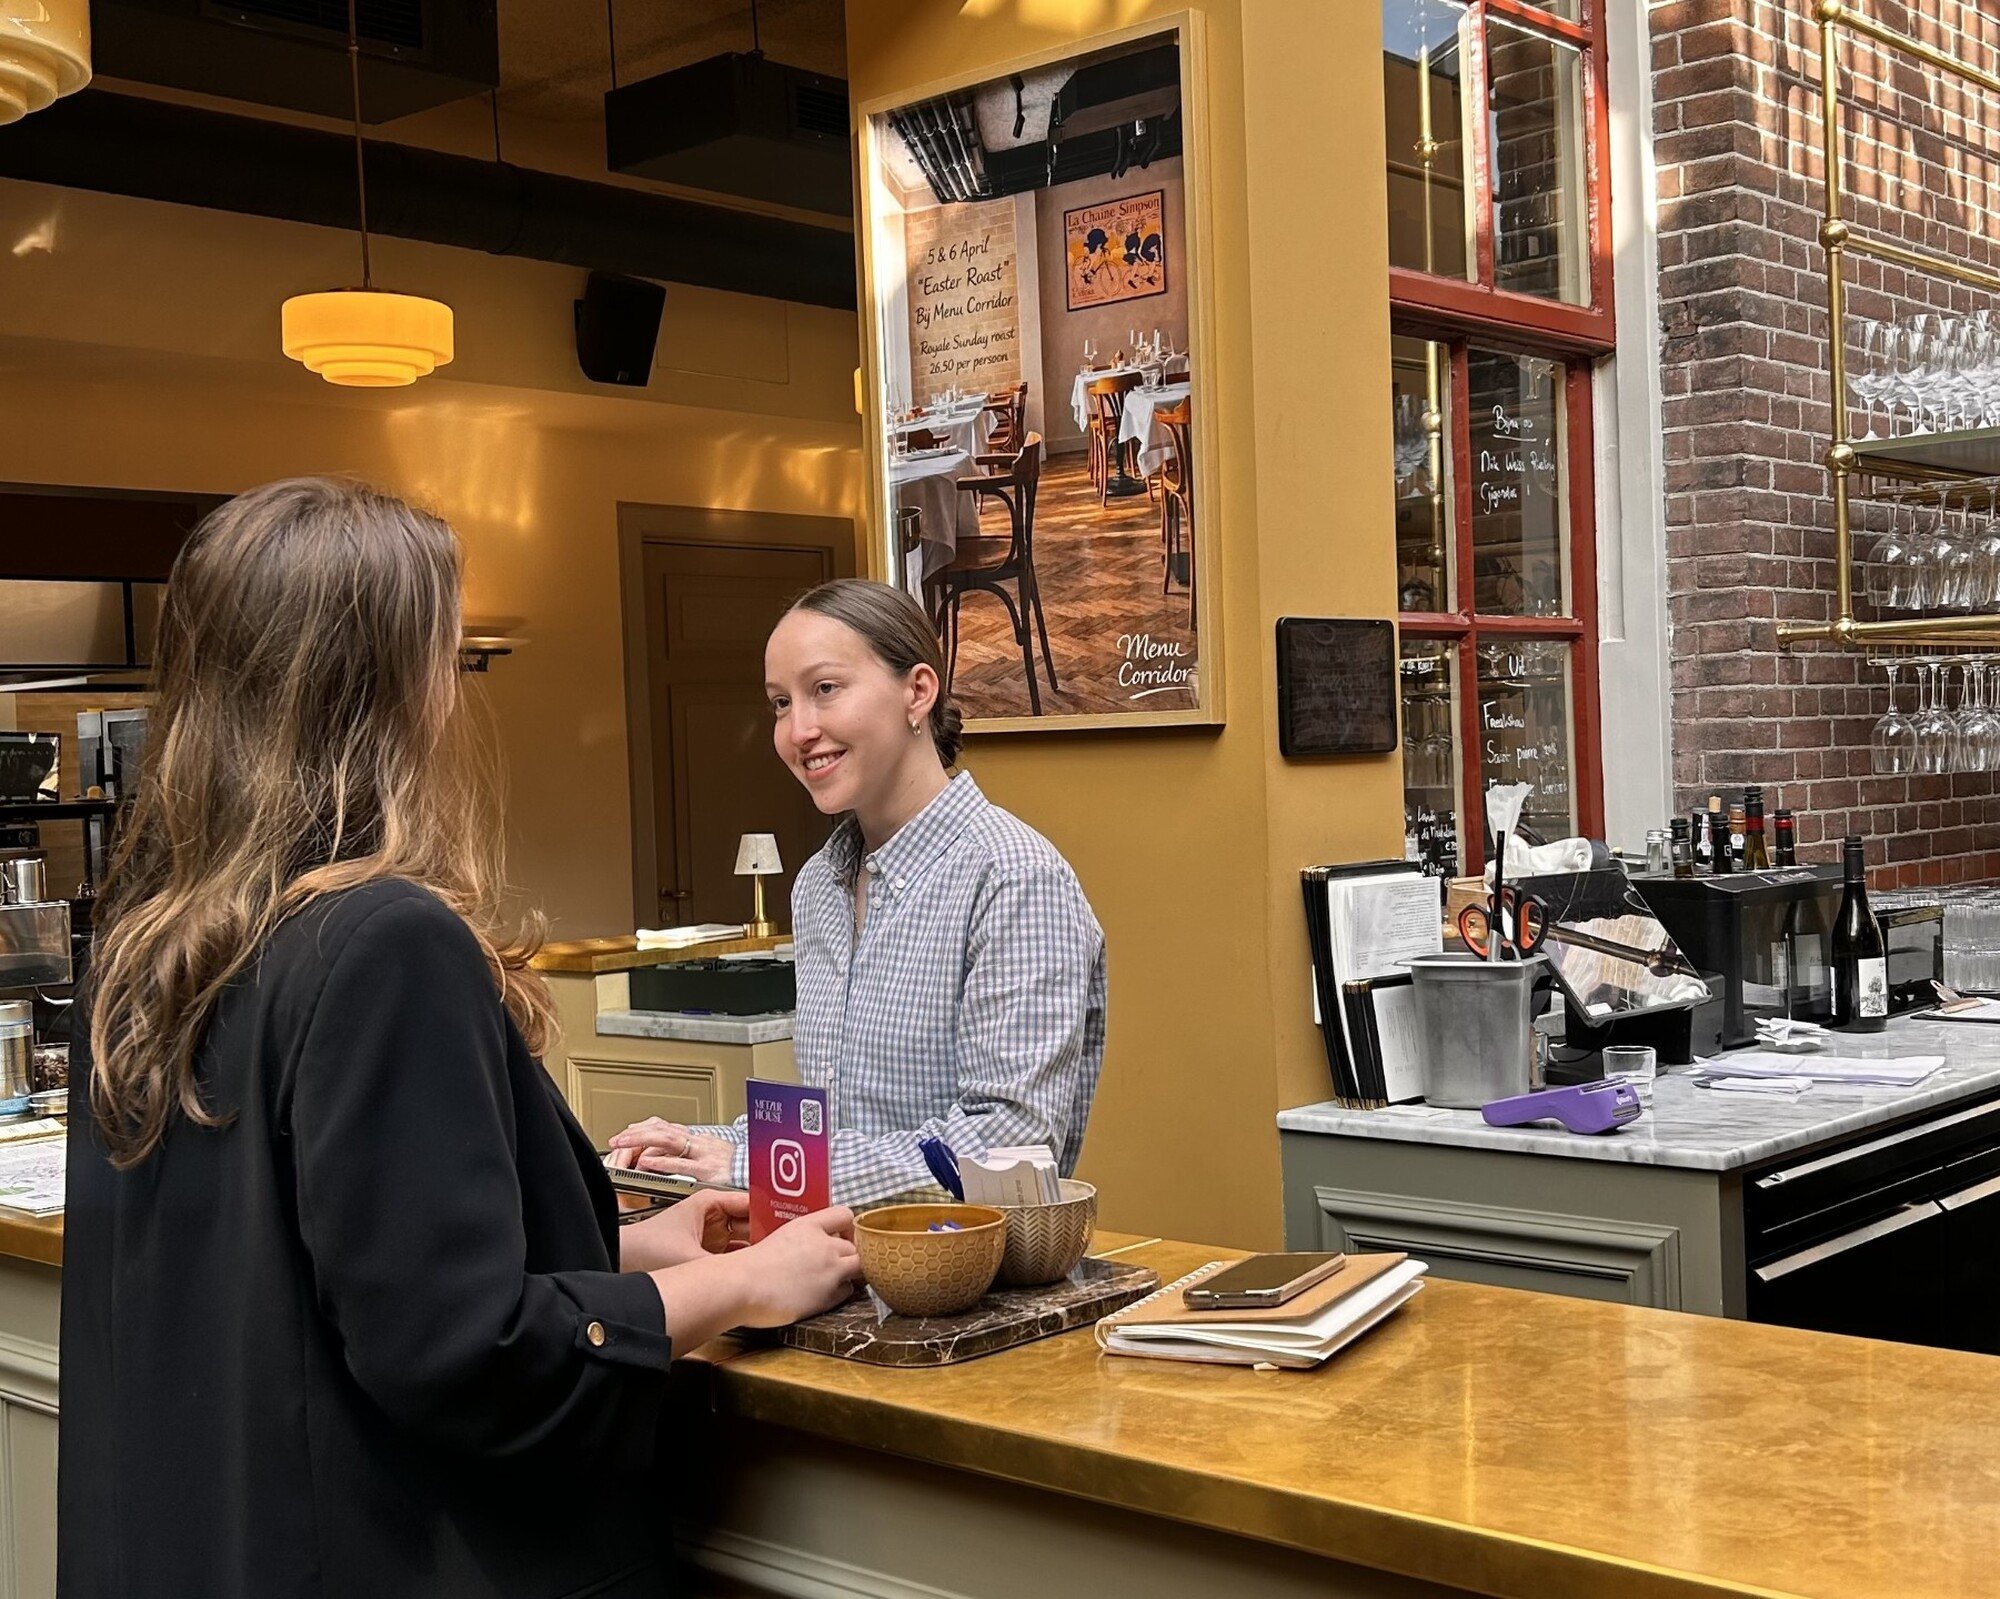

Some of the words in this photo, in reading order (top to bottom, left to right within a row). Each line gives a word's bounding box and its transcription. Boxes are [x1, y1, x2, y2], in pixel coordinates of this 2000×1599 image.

[1067, 214, 1080, 227] La
[1119, 198, 1160, 216] Simpson
[926, 248, 935, 265] 5
[937, 246, 946, 263] &
[949, 243, 957, 261] 6
[960, 234, 990, 263] April
[915, 306, 930, 330] Bij
[933, 302, 964, 322] Menu
[966, 290, 1013, 314] Corridor
[920, 337, 951, 359] Royale
[952, 331, 989, 350] Sunday
[990, 326, 1016, 342] roast
[956, 359, 972, 375] per
[973, 352, 1009, 372] persoon
[1116, 633, 1190, 661] Menu
[1118, 660, 1193, 687] Corridor
[754, 1109, 783, 1124] HOUSE
